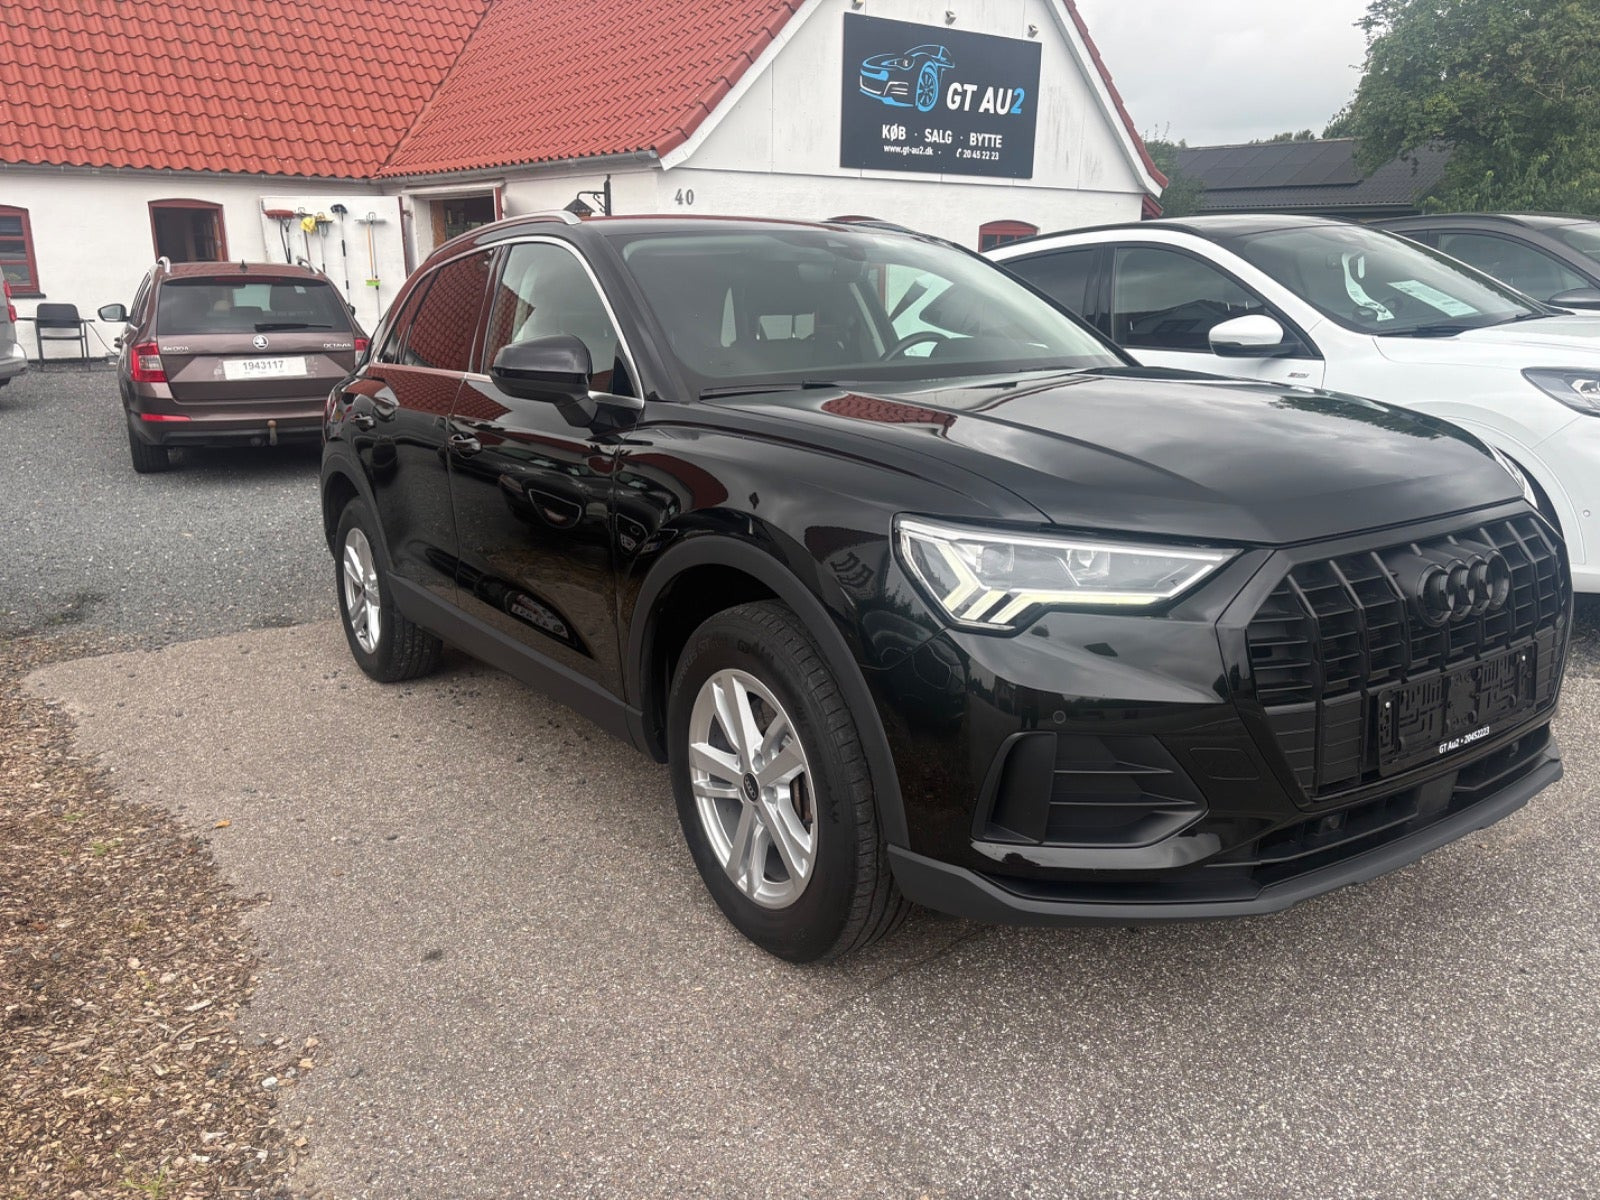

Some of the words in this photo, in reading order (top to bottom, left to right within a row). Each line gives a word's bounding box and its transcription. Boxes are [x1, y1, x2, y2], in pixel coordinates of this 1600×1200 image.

[946, 82, 978, 110] GT
[978, 86, 1025, 115] AU2
[882, 124, 906, 141] KØB
[924, 128, 953, 144] SALG
[969, 132, 1003, 148] BYTTE
[883, 145, 934, 156] www.gt-au2.dk
[963, 149, 971, 159] 20
[982, 150, 990, 160] 22
[990, 151, 999, 160] 23
[674, 188, 695, 206] 40
[242, 360, 285, 371] 1943117
[1439, 743, 1448, 754] GT
